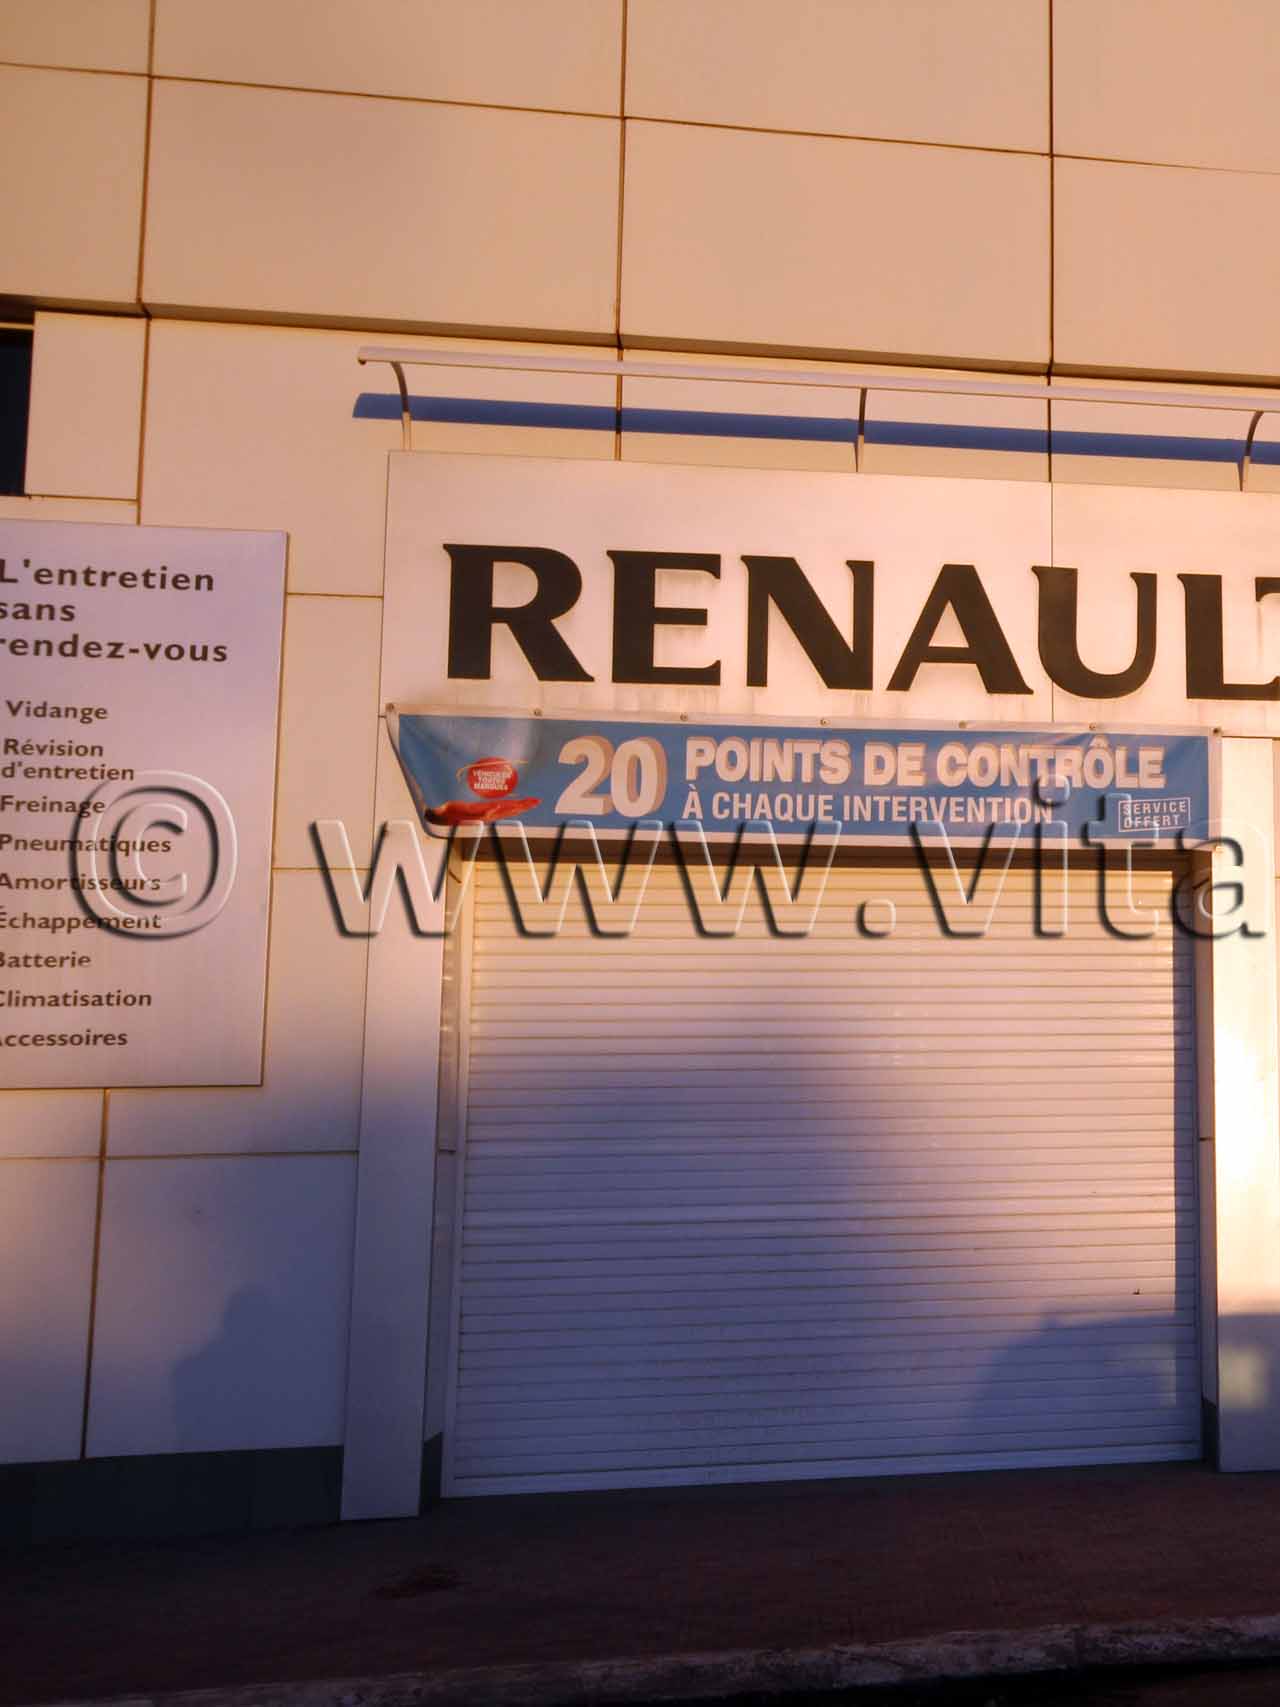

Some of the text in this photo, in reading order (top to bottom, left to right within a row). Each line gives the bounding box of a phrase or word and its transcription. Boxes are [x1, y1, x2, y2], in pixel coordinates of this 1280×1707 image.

[0, 558, 215, 591] L'entretien
[6, 700, 109, 724] Vidange
[3, 738, 104, 757] Révision
[1, 761, 135, 781] d'entretien
[686, 735, 1166, 789] POINTS DE CONTRÔLE
[555, 735, 668, 818] 20
[0, 795, 105, 818] Freinage
[682, 784, 1053, 825] À CHAQUE INTERVENTION
[1123, 801, 1186, 816] SERVICE
[1124, 815, 1180, 828] OFFERT
[0, 834, 171, 856] Pneumatiques
[0, 1029, 128, 1048] ccessoires
